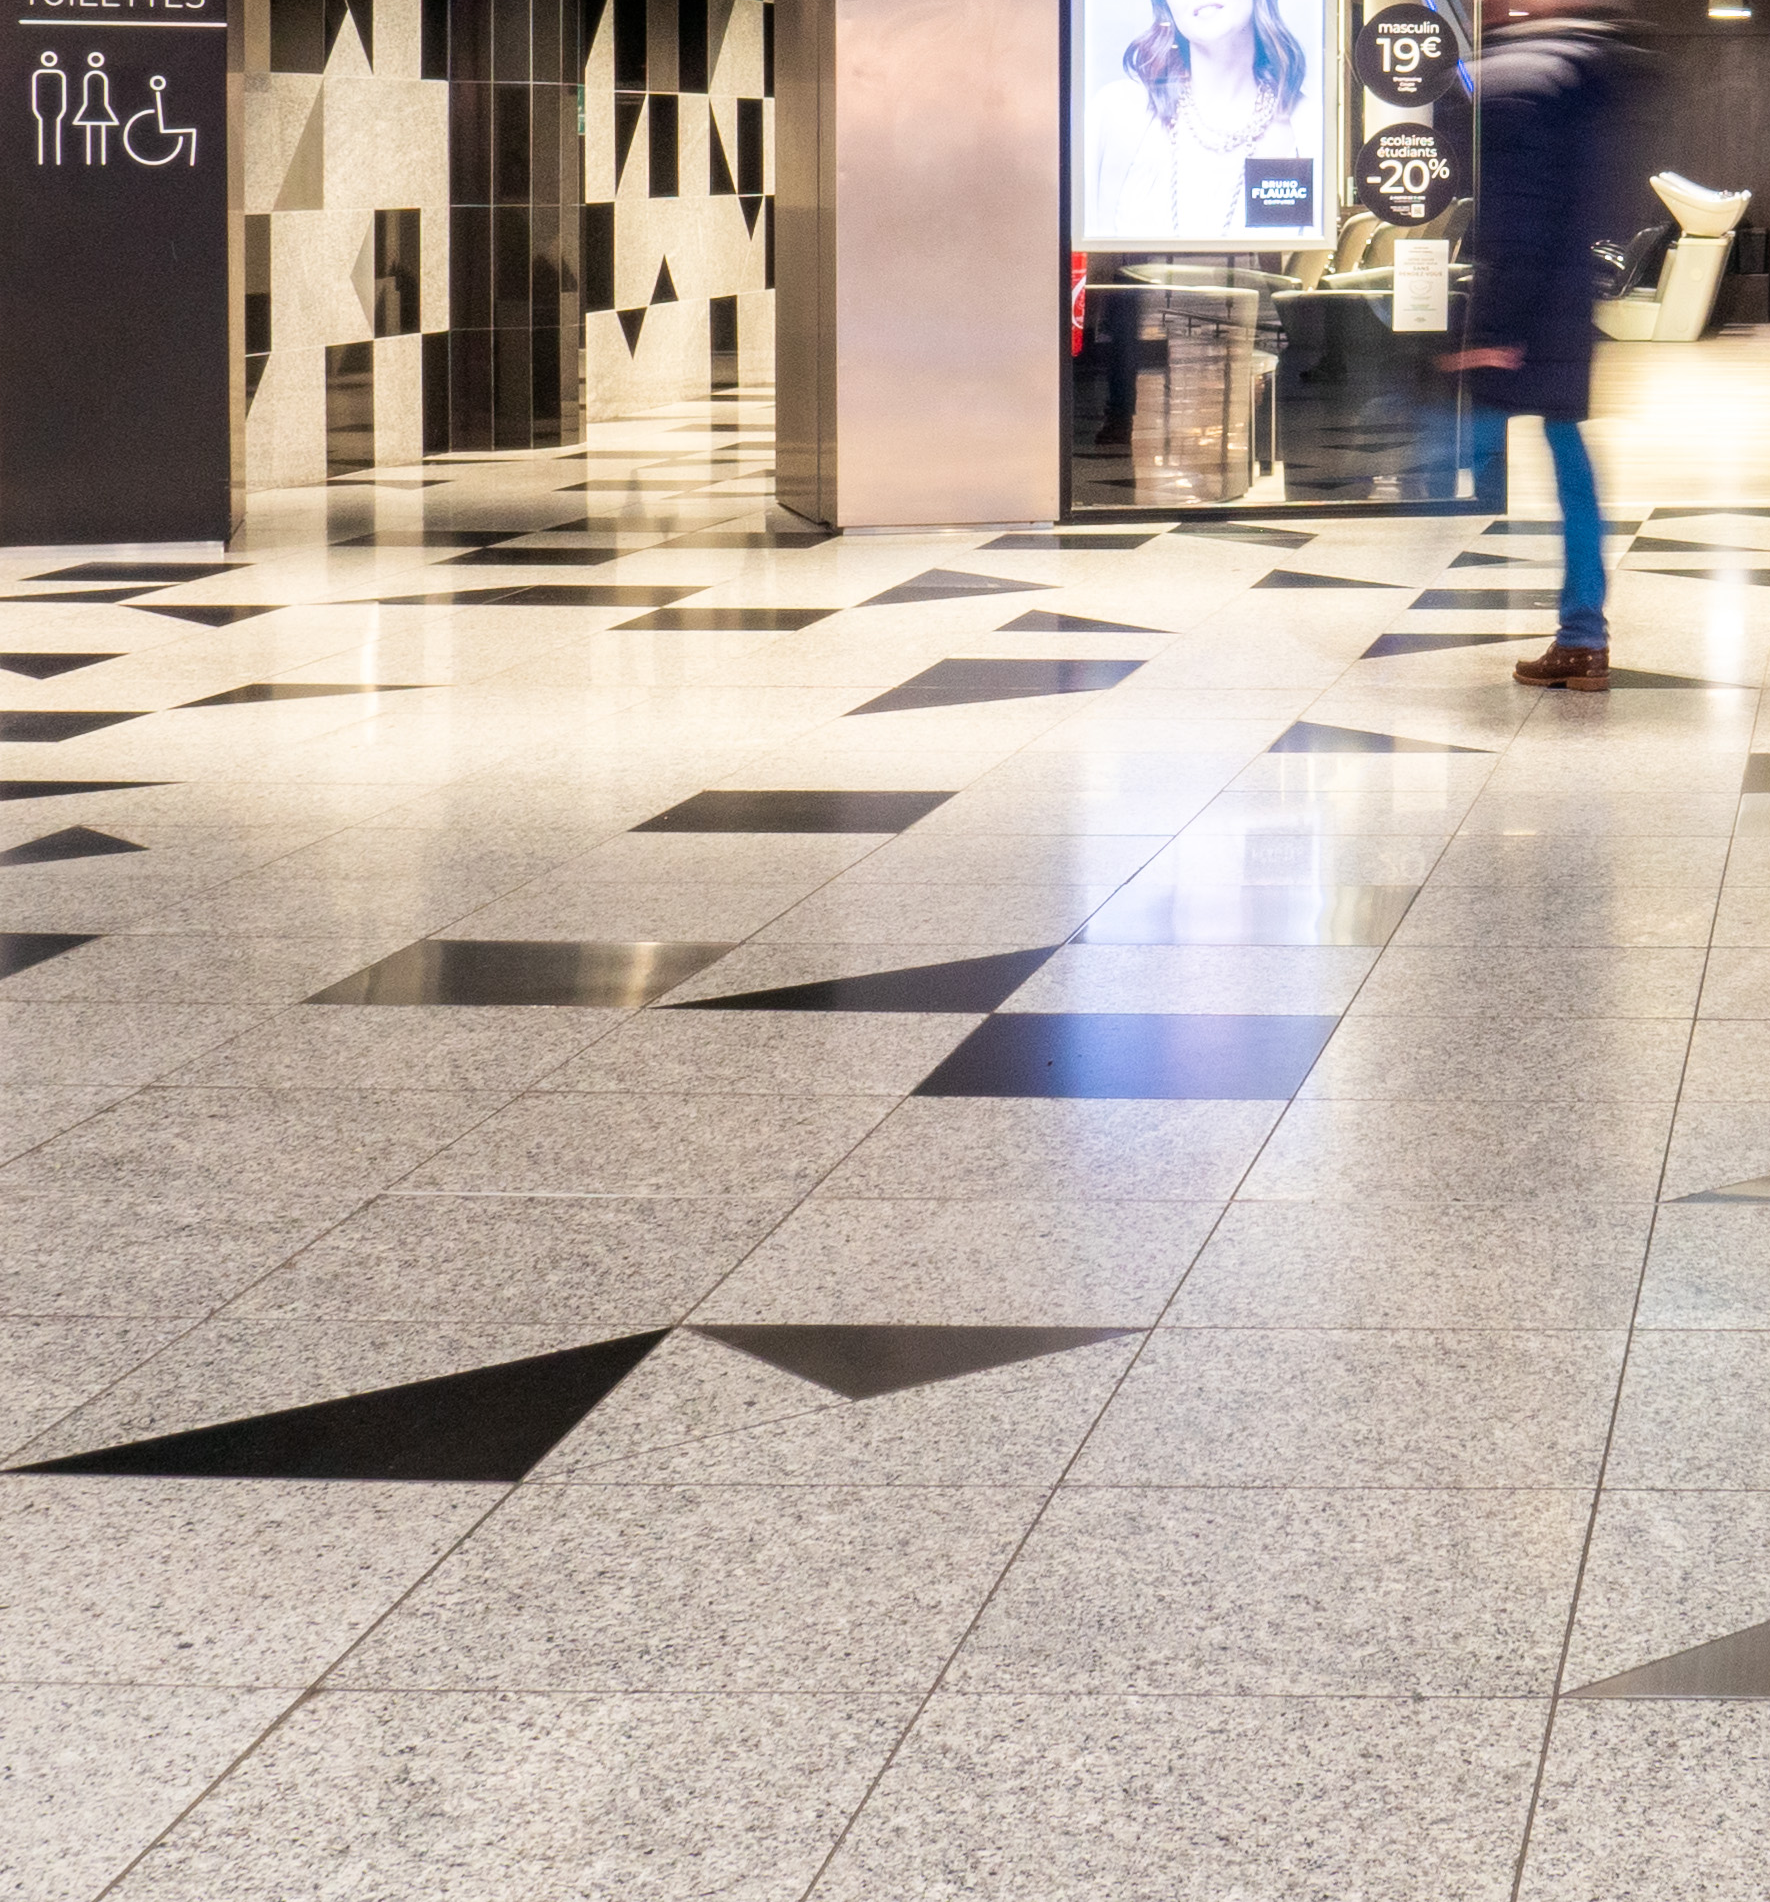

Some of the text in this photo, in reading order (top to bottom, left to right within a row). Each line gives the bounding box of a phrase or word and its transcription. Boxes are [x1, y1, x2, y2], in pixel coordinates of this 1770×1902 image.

[1378, 20, 1440, 34] masculin
[1375, 36, 1442, 73] 19€
[1379, 134, 1435, 147] scolaires
[1376, 146, 1438, 158] étudiants
[1366, 158, 1450, 194] -20%
[1251, 187, 1308, 199] FLAUJAC
